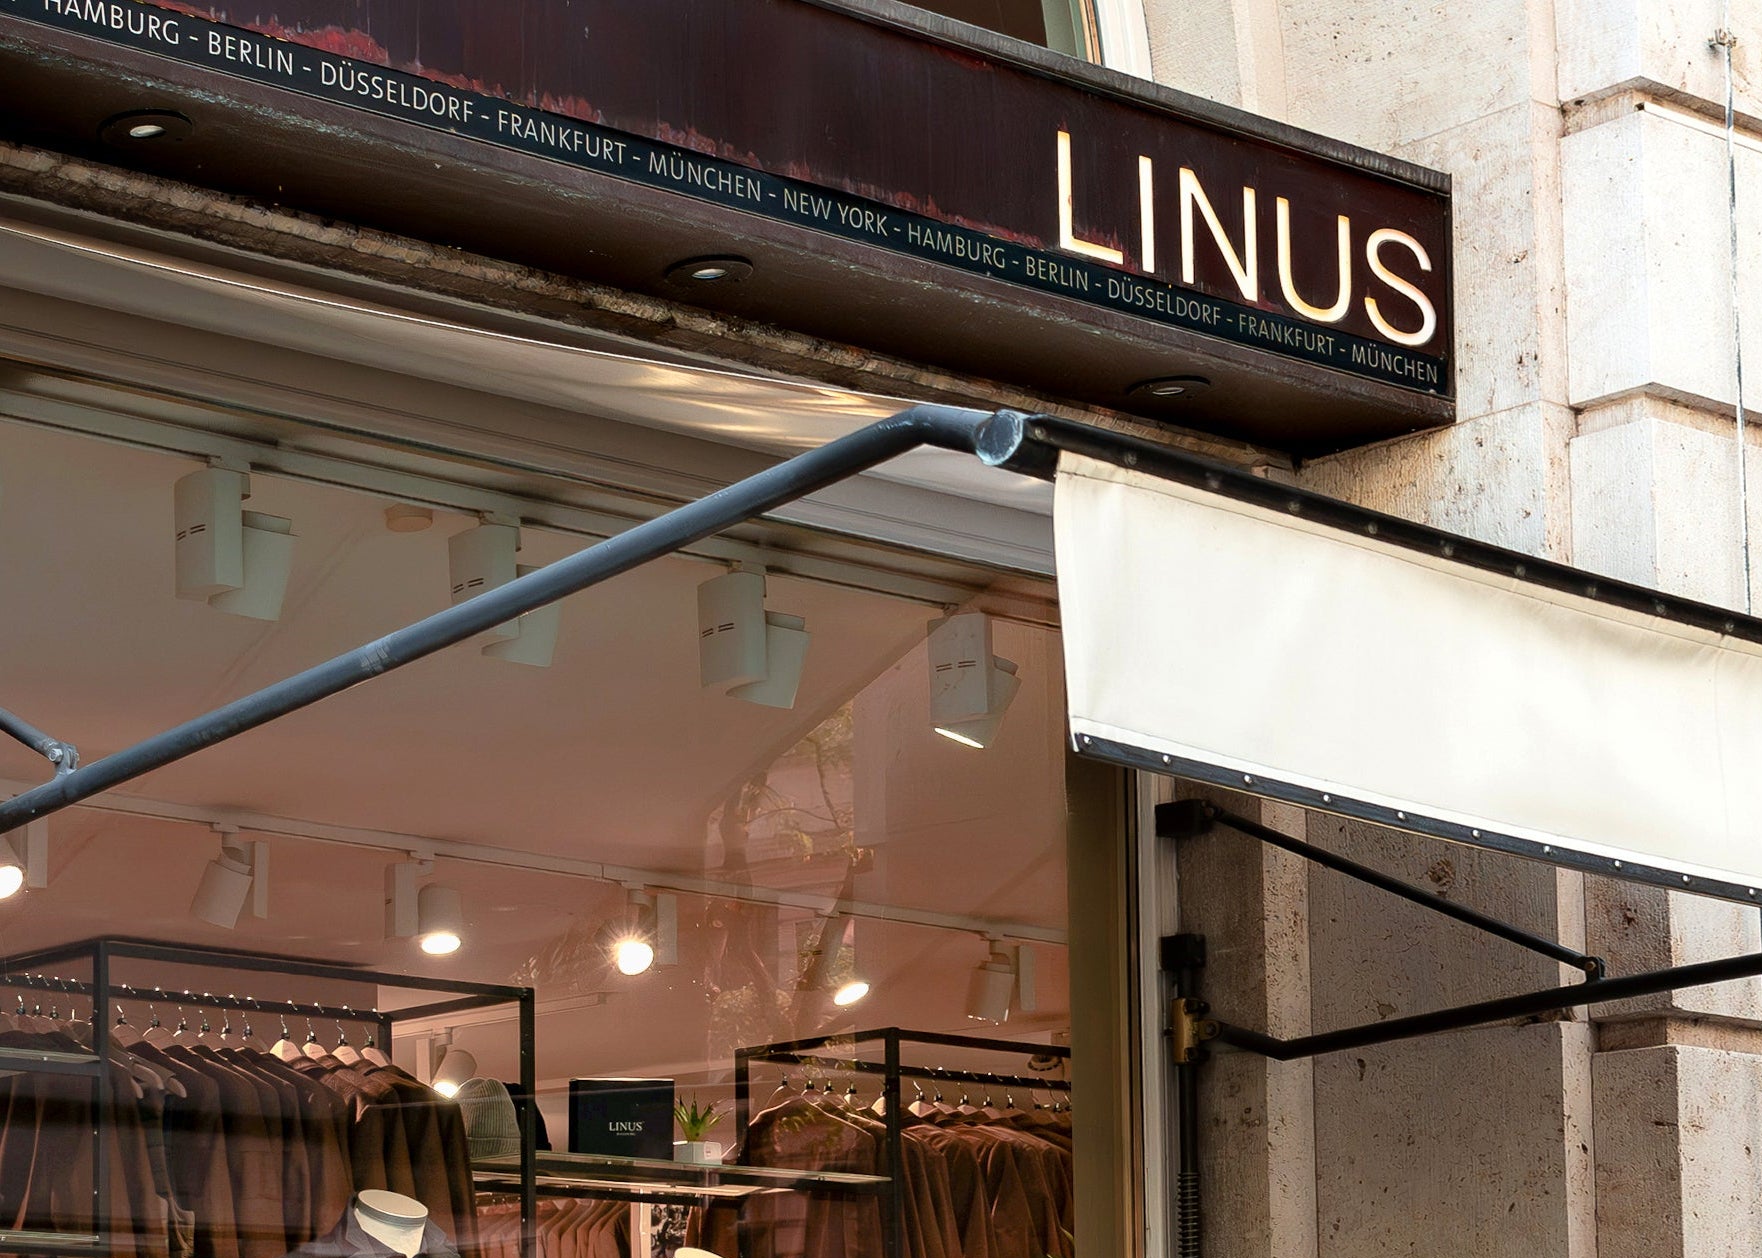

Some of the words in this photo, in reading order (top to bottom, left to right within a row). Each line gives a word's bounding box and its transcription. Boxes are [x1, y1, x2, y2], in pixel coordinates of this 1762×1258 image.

[207, 31, 294, 76] BERLIN
[320, 60, 475, 124] DÜSSELDORF
[497, 109, 627, 165] FRANKFURT
[648, 150, 763, 203] MÜNCHEN
[783, 188, 832, 222] NEW
[836, 201, 889, 238] YORK
[907, 223, 1007, 272] HAMBURG
[1025, 254, 1090, 292] BERLIN
[1107, 274, 1222, 327] DÜSSELDORF
[1238, 312, 1336, 358] FRANKFURT
[1351, 337, 1439, 385] MÜNCHEN
[1057, 130, 1438, 346] LINUS
[609, 1121, 643, 1132] LINUS
